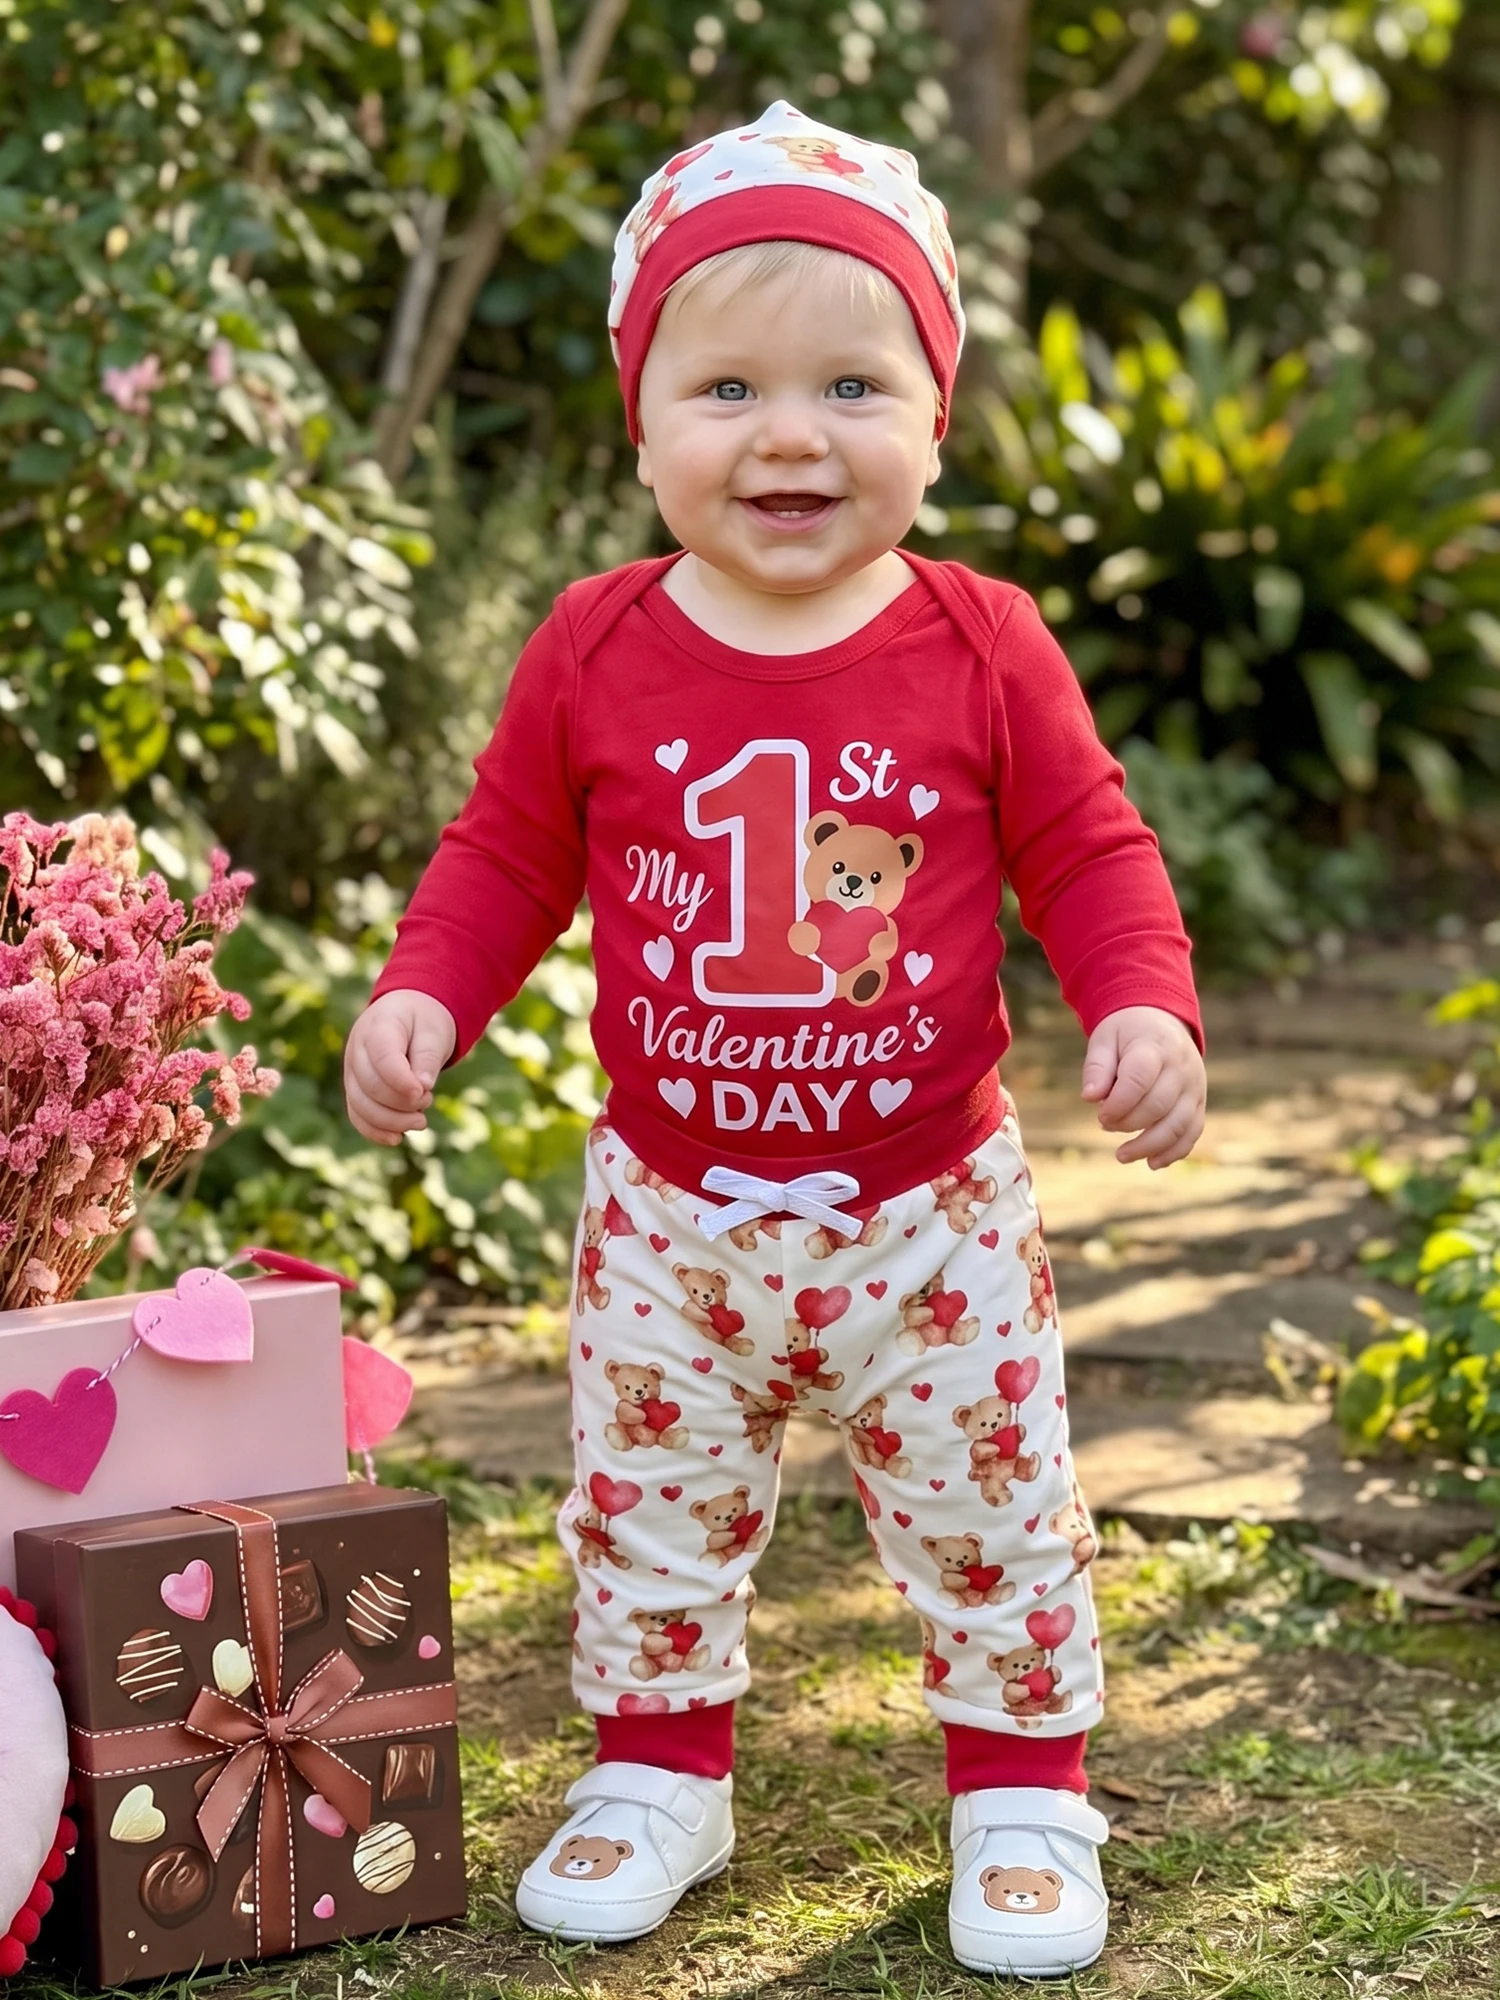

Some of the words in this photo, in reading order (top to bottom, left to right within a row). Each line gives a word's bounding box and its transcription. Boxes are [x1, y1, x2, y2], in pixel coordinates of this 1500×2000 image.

[626, 845, 714, 933] My
[684, 738, 838, 1008] 1
[829, 741, 900, 803] St
[627, 996, 943, 1070] Valentine's
[711, 1079, 858, 1133] DAY
